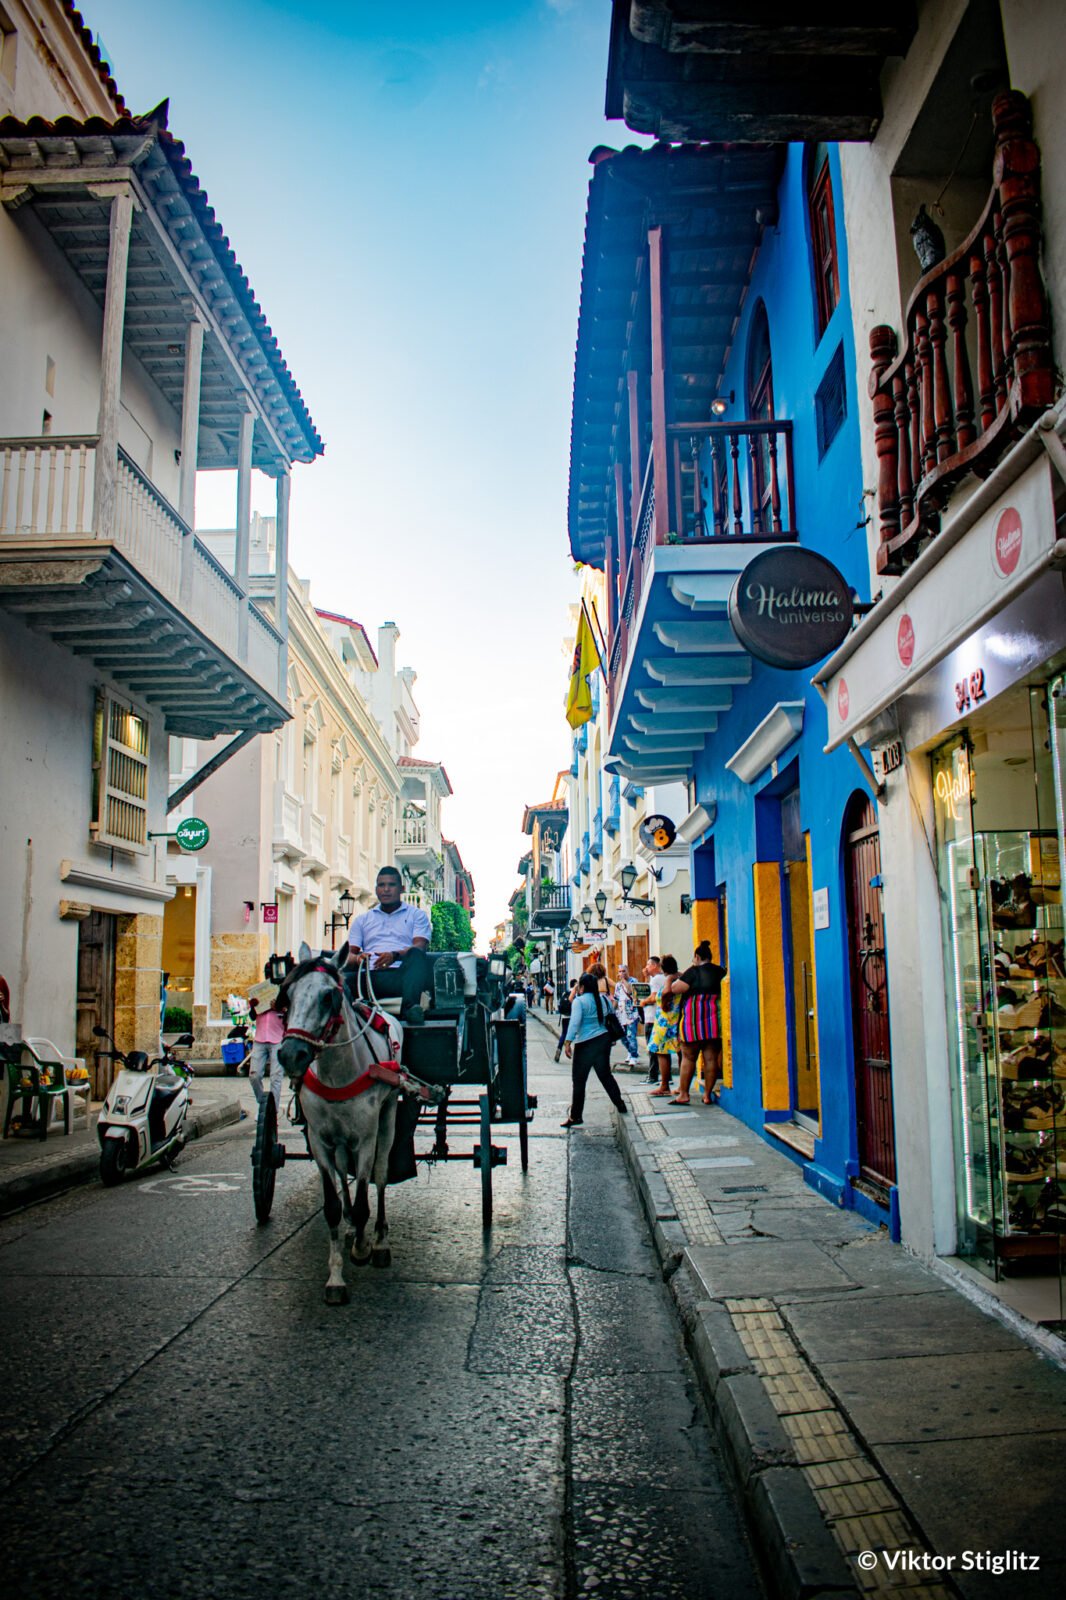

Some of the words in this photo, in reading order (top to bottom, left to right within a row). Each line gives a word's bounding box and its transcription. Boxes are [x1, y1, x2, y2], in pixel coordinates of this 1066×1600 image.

[746, 583, 841, 619] Halima
[779, 609, 845, 624] universo
[970, 667, 987, 704] 62
